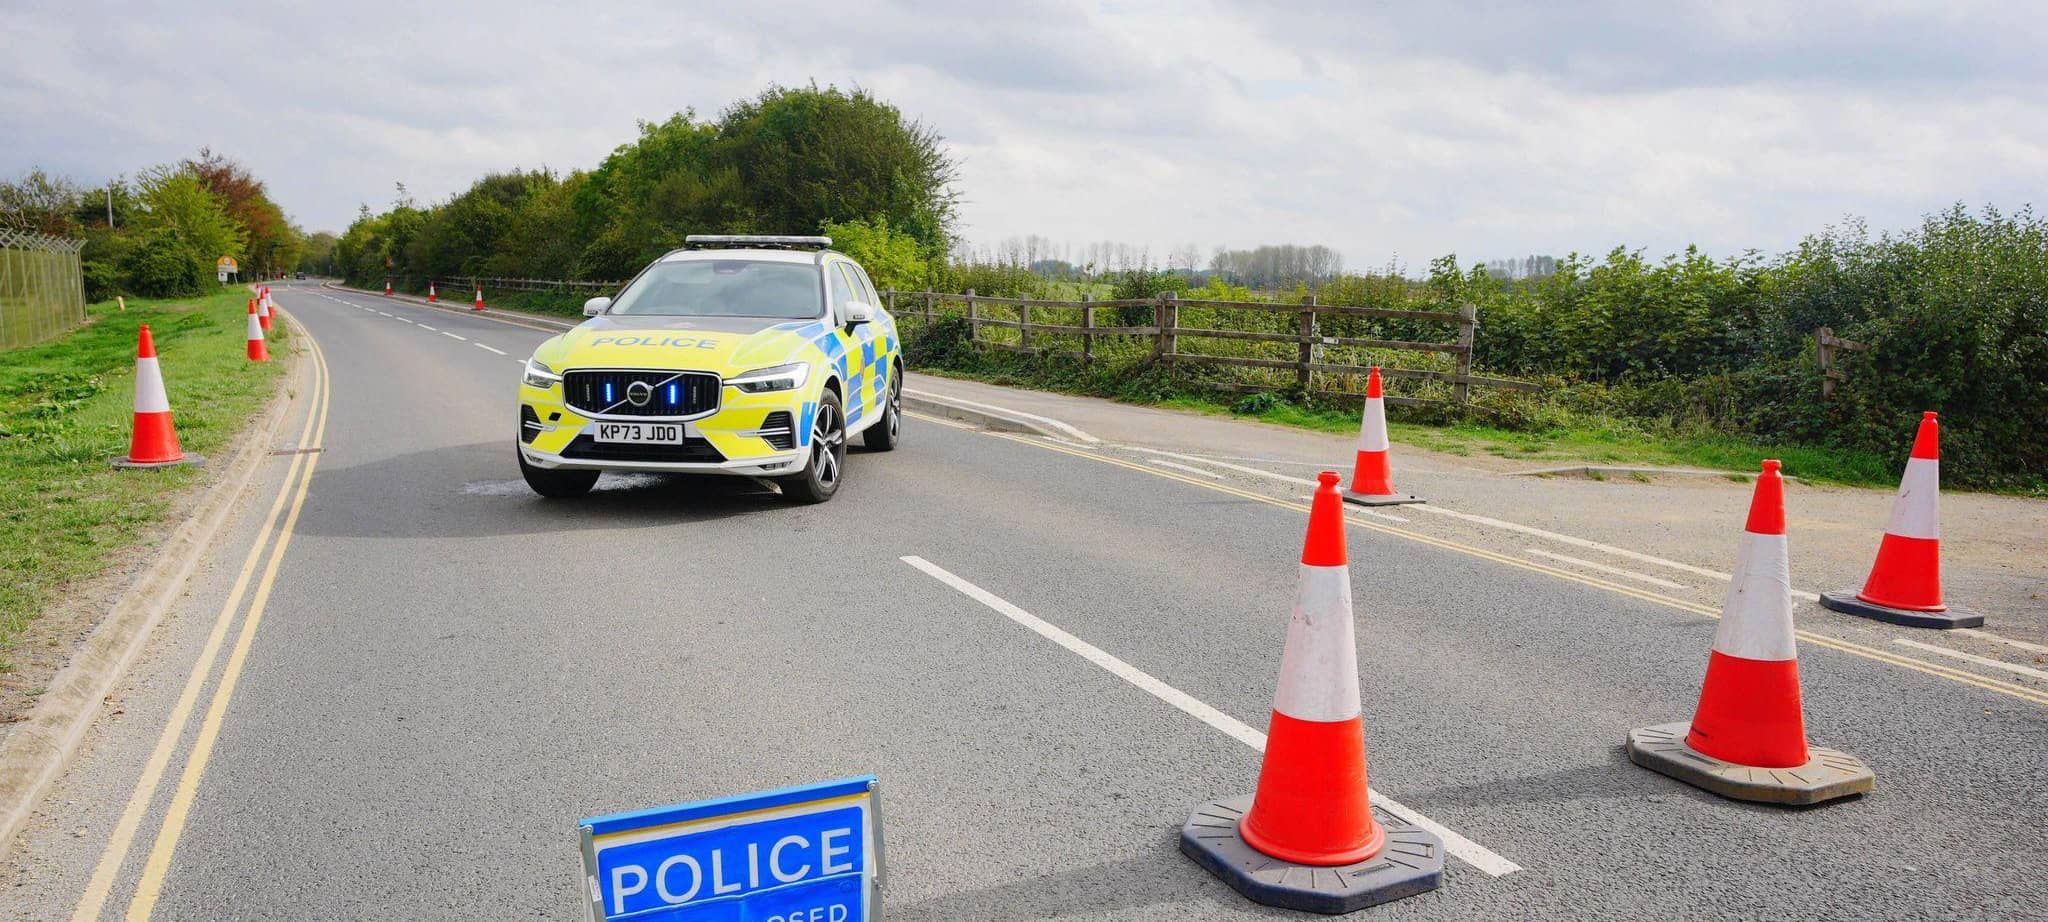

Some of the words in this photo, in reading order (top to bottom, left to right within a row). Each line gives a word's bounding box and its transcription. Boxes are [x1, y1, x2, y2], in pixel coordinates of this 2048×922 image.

[592, 336, 720, 349] POLICE
[600, 424, 640, 440] KP73
[646, 426, 676, 441] JDO
[611, 828, 852, 914] POLICE
